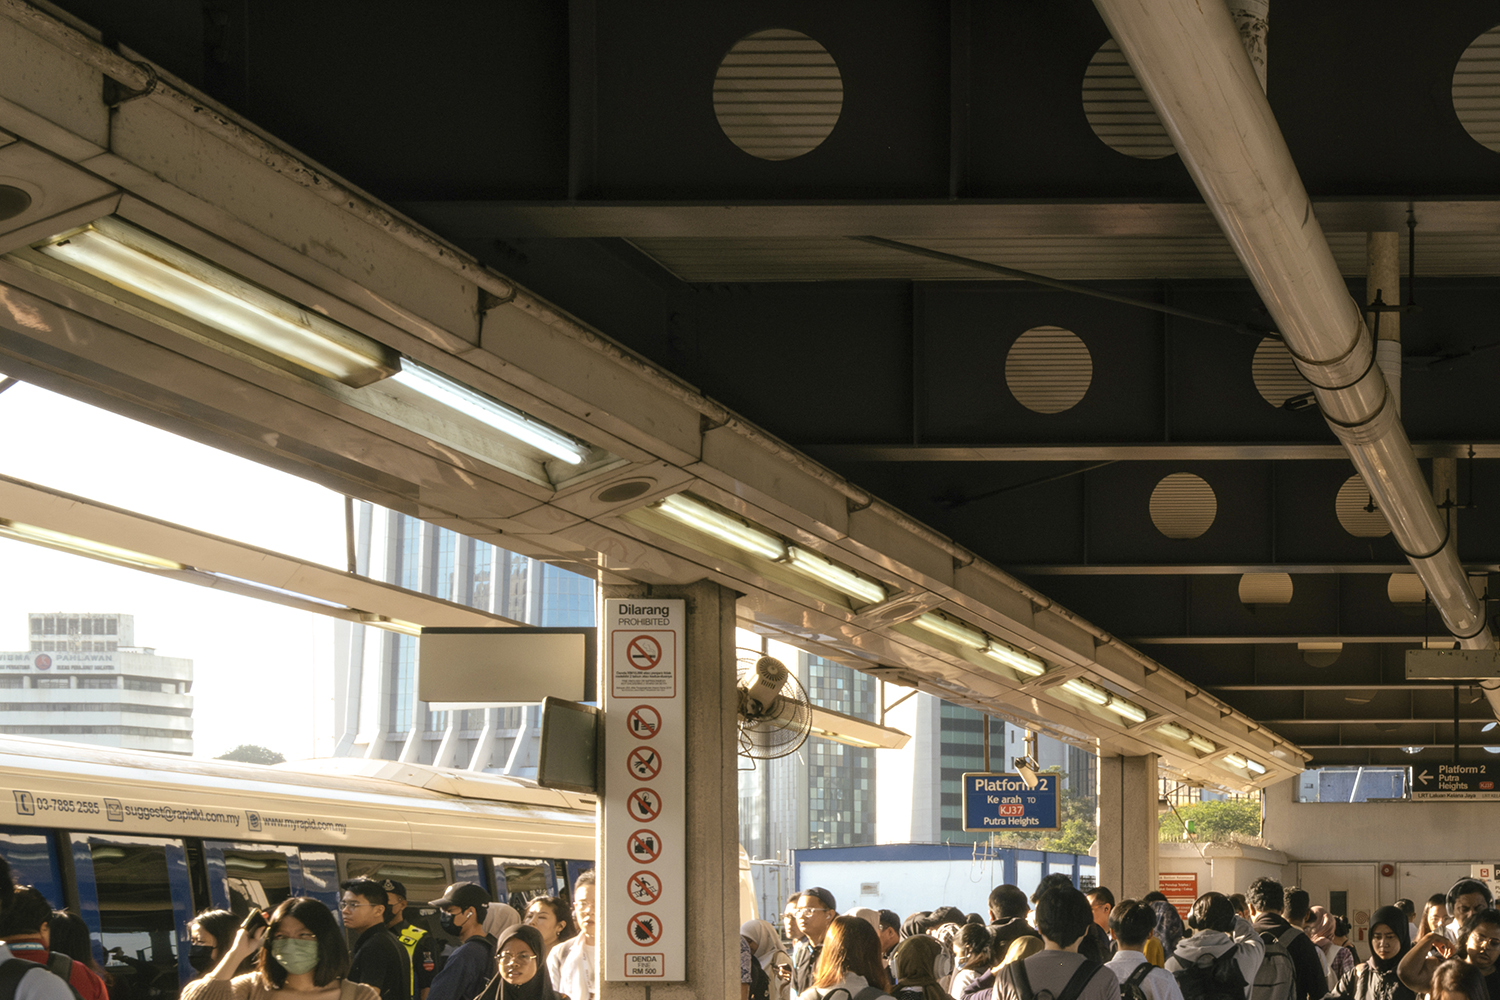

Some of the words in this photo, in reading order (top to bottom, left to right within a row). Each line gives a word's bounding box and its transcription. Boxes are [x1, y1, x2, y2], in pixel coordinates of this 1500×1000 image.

[618, 604, 670, 618] Dilarang
[618, 617, 670, 626] PROHIBITED
[56, 654, 112, 662] PAHLAWAN
[1438, 764, 1478, 774] Platform
[1480, 764, 1486, 774] 2
[1438, 774, 1460, 782] Putra
[1039, 778, 1048, 791] 2
[1438, 782, 1468, 791] Heights
[987, 795, 999, 804] Ke
[1001, 795, 1022, 804] arah
[36, 797, 75, 812] 03-7885
[77, 801, 100, 814] 2585
[1000, 806, 1023, 815] KJ37
[124, 805, 241, 827] suggest@rapidkl.com.my
[262, 816, 347, 834] www.myrapid.com.my
[983, 816, 1007, 826] Putra
[1008, 816, 1040, 827] Heights
